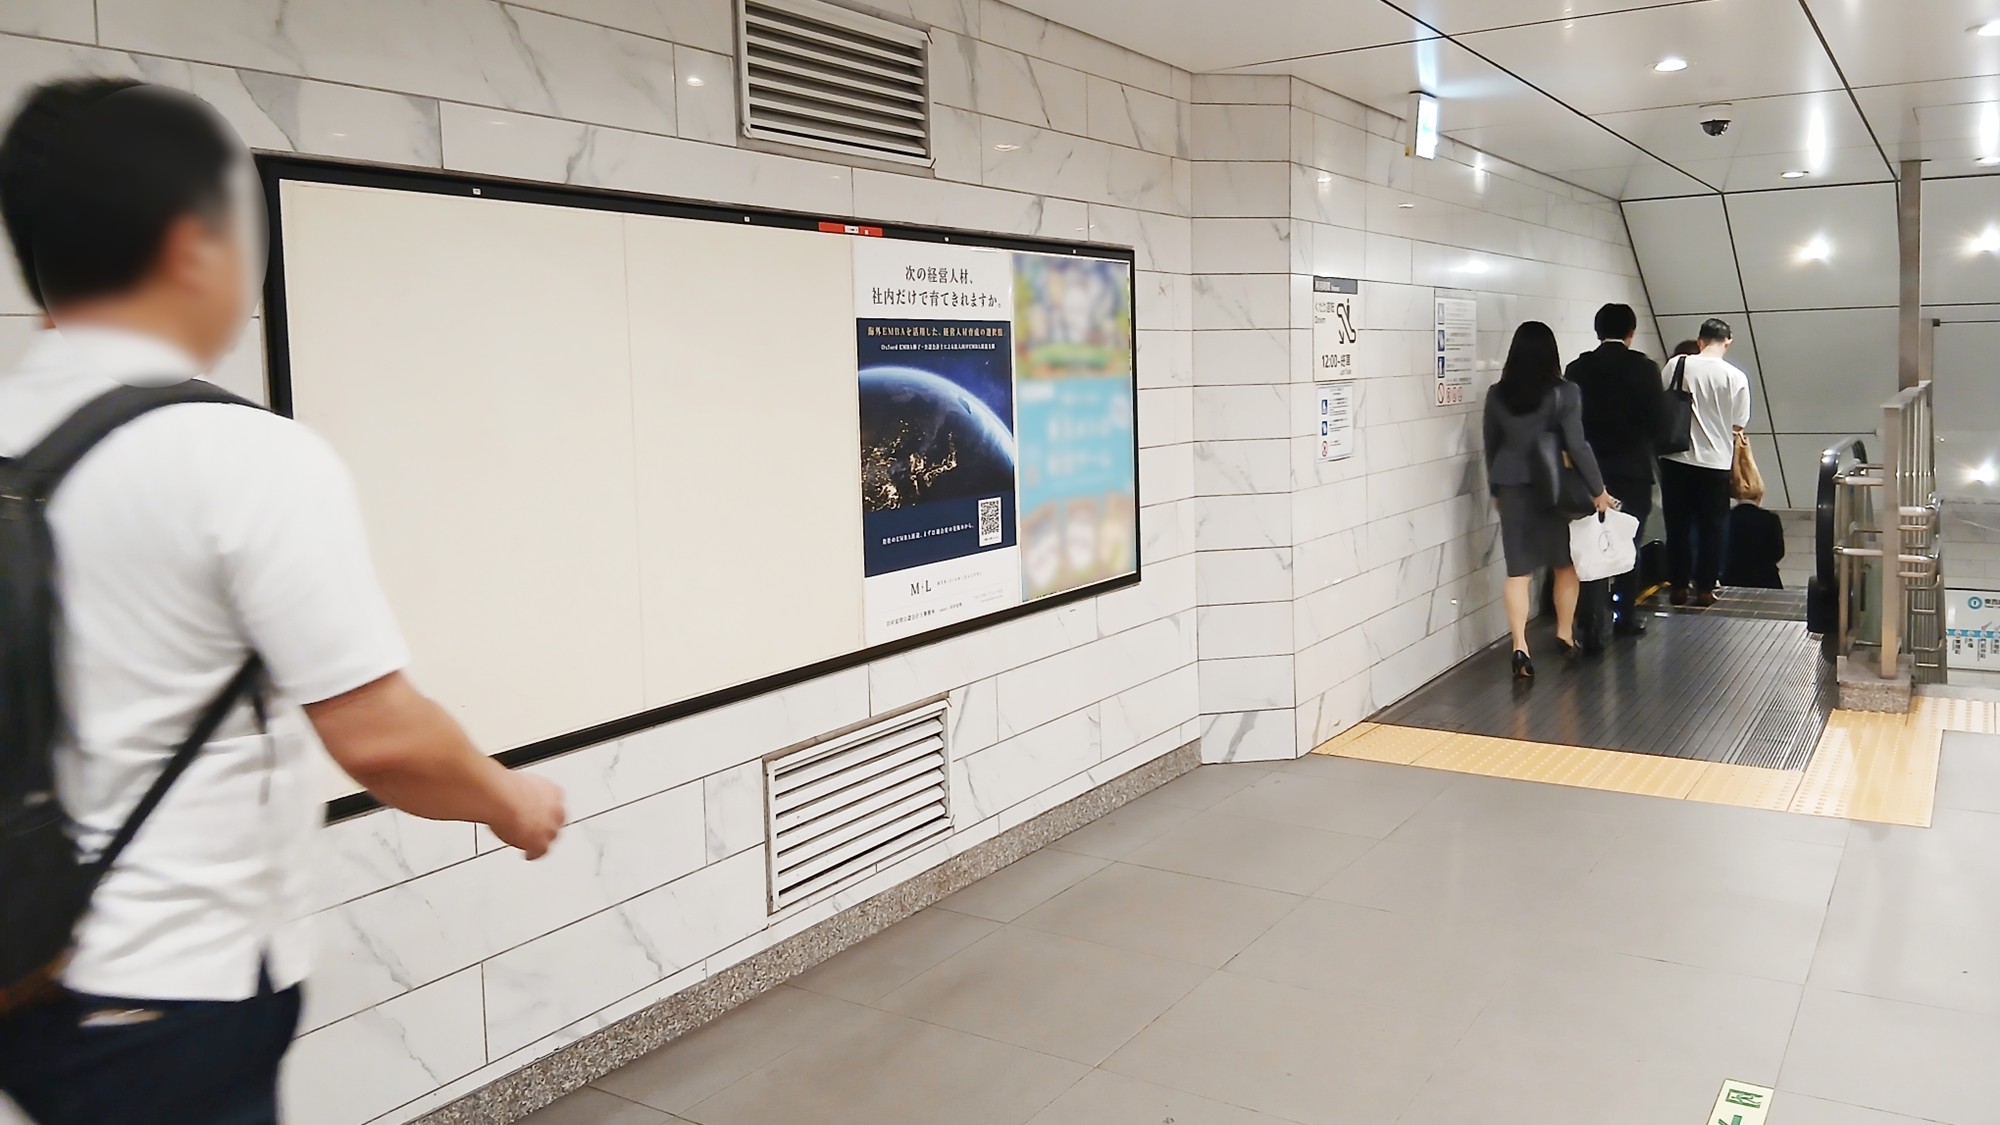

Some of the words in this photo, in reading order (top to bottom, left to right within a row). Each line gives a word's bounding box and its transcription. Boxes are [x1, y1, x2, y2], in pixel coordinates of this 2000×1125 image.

[905, 265, 973, 285] 次の経営人材、
[872, 287, 1001, 308] 社内だけで育てきれますか。
